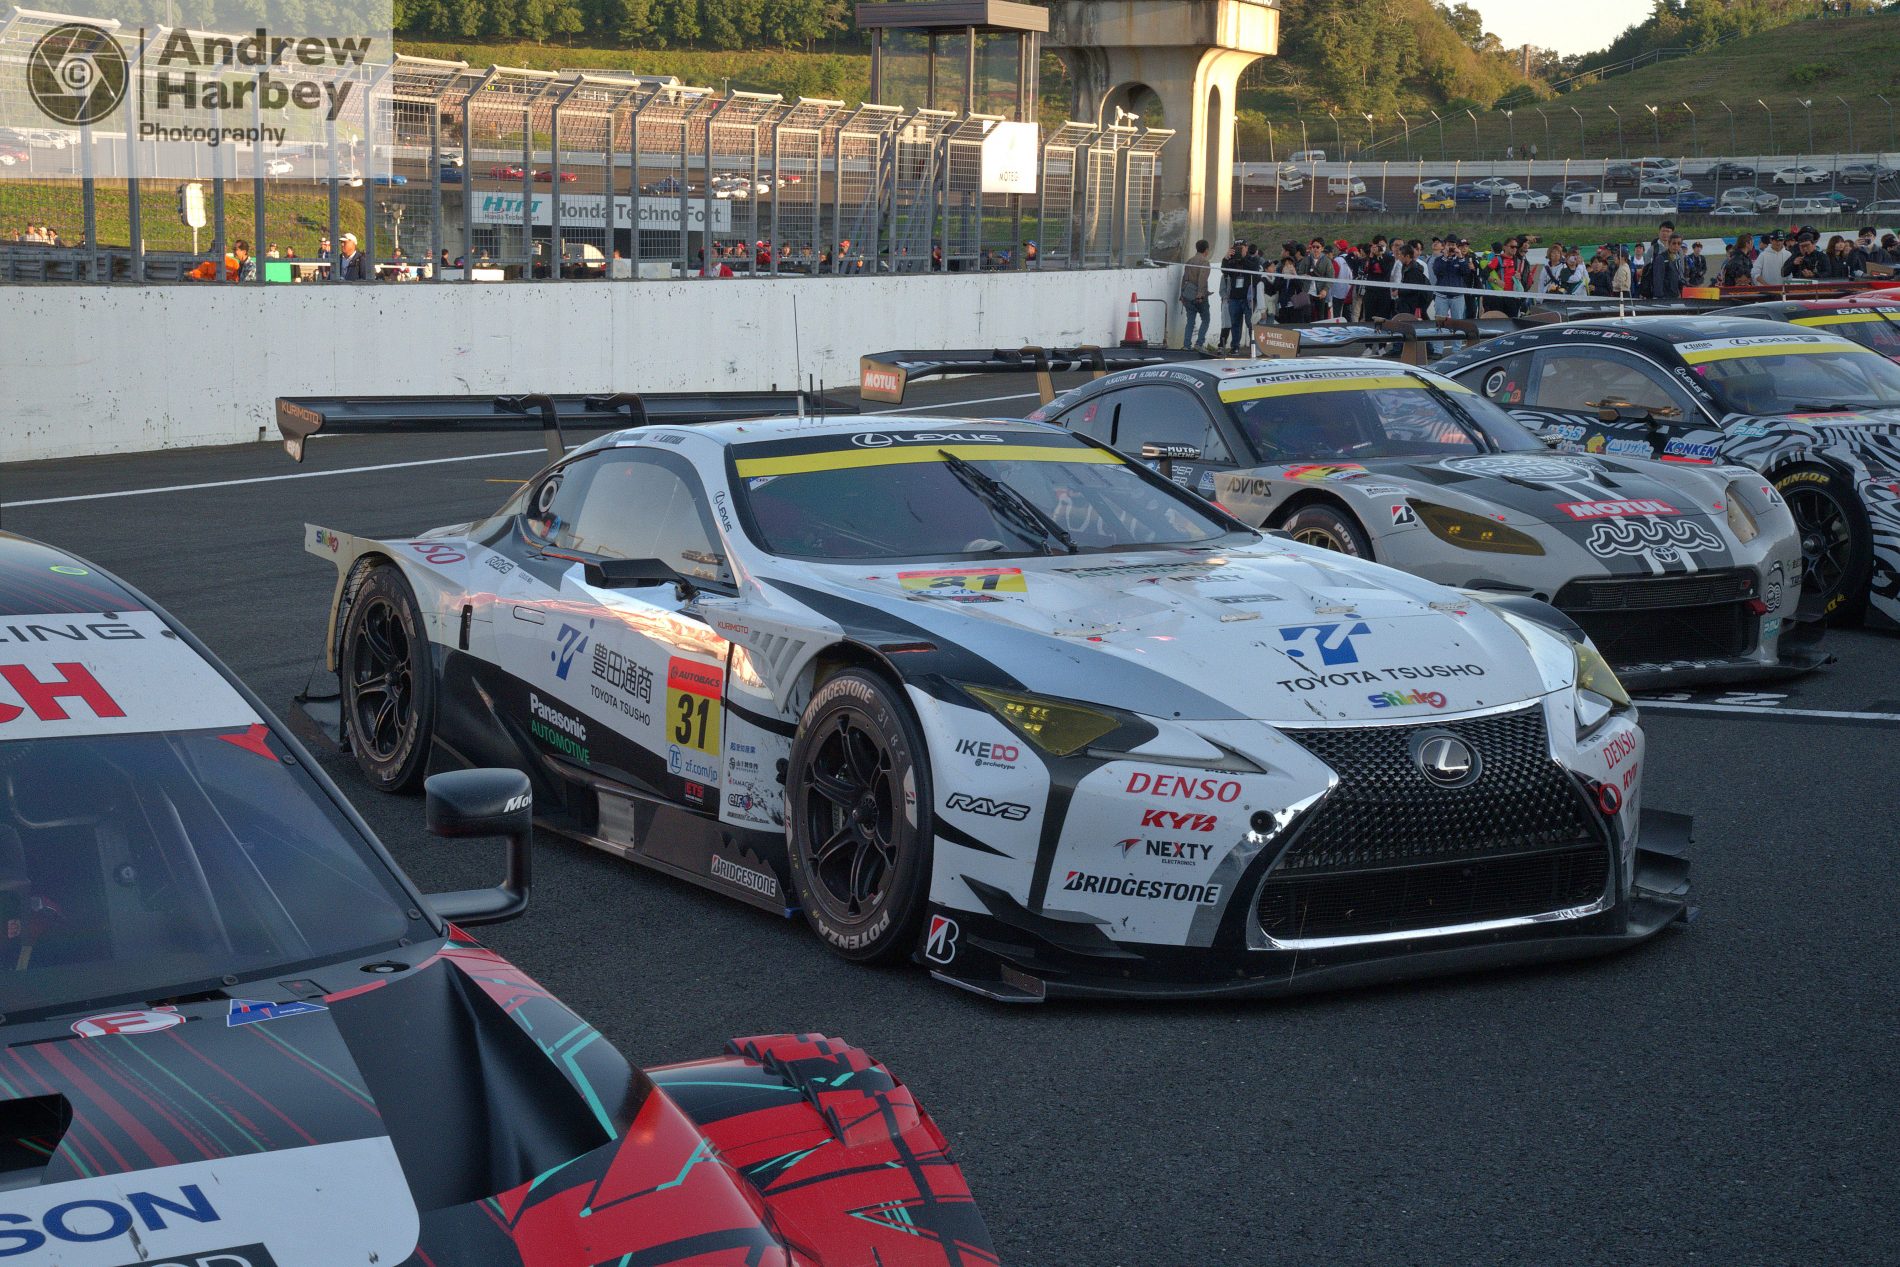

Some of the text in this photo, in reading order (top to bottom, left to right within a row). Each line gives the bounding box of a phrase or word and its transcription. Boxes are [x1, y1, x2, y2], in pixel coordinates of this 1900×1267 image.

[1749, 336, 1798, 344] LEXUS
[864, 372, 897, 390] MOTUL
[1682, 372, 1703, 393] LEXUS
[893, 433, 1004, 443] LEXUS
[717, 501, 733, 533] LEXUS
[1568, 500, 1673, 518] MOTUL
[0, 623, 146, 643] ING
[592, 642, 654, 705] 豊田通商
[1277, 663, 1485, 693] TOYOTA TSUSHO
[530, 692, 587, 741] Panasonic
[591, 684, 651, 726] TOYOTA TSUSHO
[675, 694, 710, 749] 31
[531, 720, 590, 765] AUTOMOTIVE
[955, 739, 1019, 762] IKEDO
[1602, 729, 1636, 770] DENSO
[982, 760, 1016, 771] archetype
[1126, 772, 1242, 803] DENSO
[946, 792, 1031, 821] RAYS
[1140, 809, 1218, 832] KYB
[1146, 839, 1214, 861] NEXTY
[1161, 858, 1196, 866] ELECTRONICS
[711, 854, 777, 897] BRIDGESTONE
[1063, 870, 1220, 904] BRIDGESTONE
[818, 909, 890, 949] POTENZA
